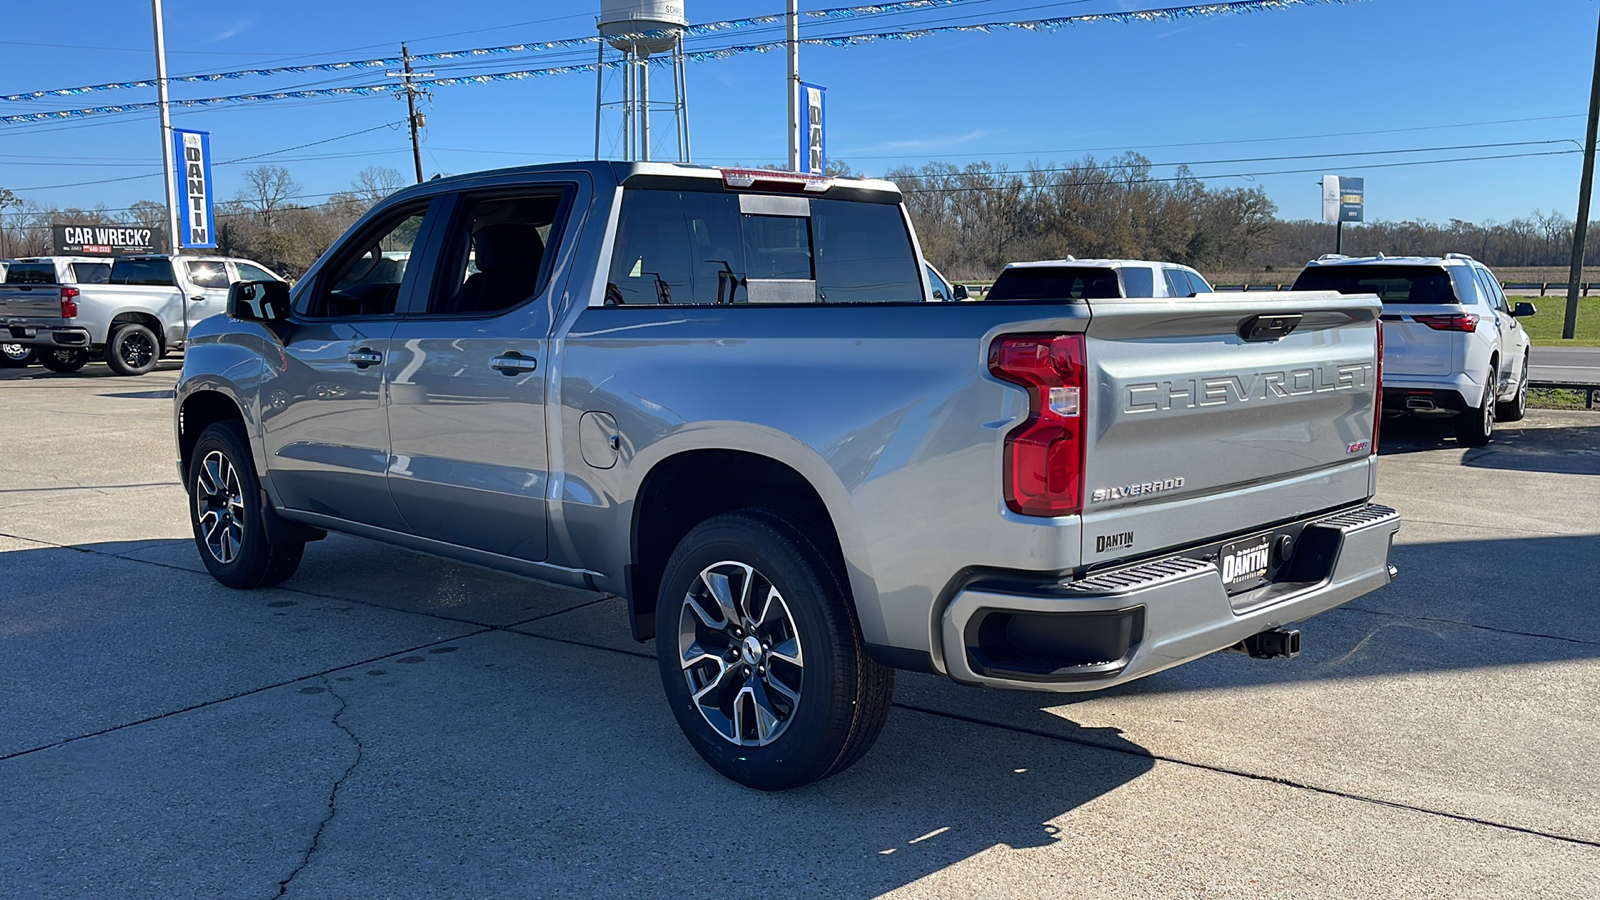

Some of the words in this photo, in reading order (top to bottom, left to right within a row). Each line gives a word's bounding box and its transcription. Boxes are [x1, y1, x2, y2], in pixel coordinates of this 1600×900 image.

[185, 147, 206, 243] DANTIN
[64, 226, 93, 245] CAR
[95, 228, 151, 246] WRECK?
[1124, 362, 1372, 414] CHEVROLET
[1092, 476, 1185, 503] SILVERADO
[1096, 531, 1134, 553] DANTIN
[1222, 548, 1269, 584] DANTIN
